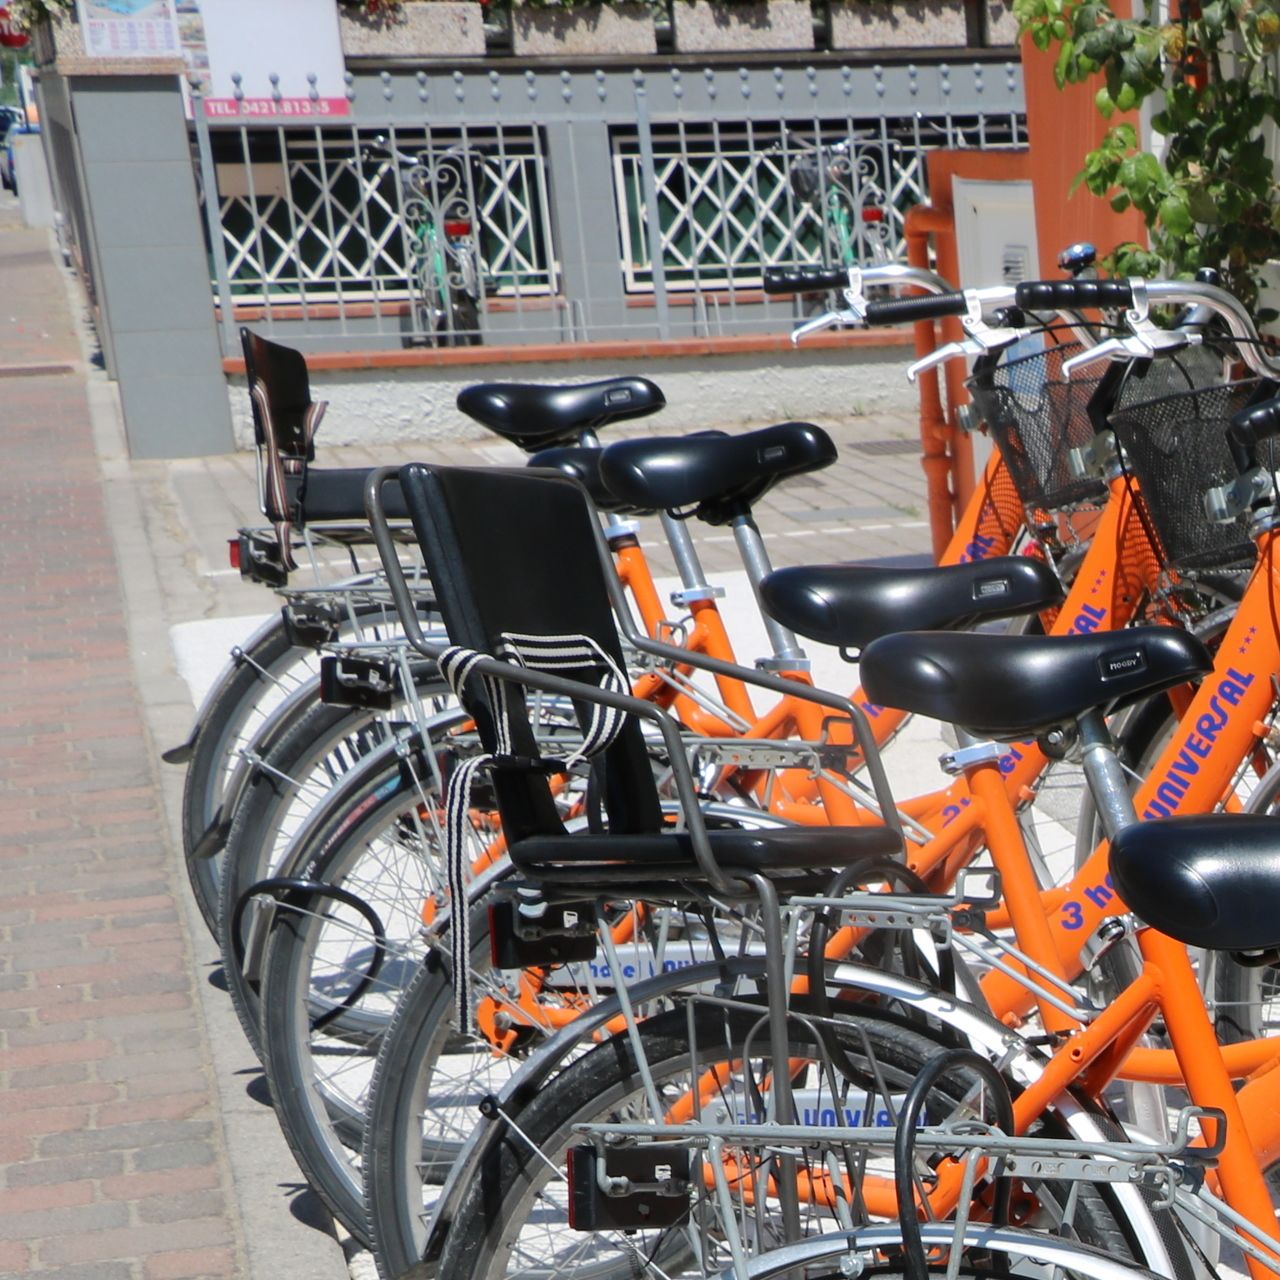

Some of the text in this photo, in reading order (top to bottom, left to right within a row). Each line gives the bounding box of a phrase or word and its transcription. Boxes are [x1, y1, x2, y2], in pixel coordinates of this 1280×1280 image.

[207, 101, 236, 115] TEL.
[1109, 658, 1138, 671] MOODY
[1061, 667, 1255, 930] 3 UNIVERSAL
